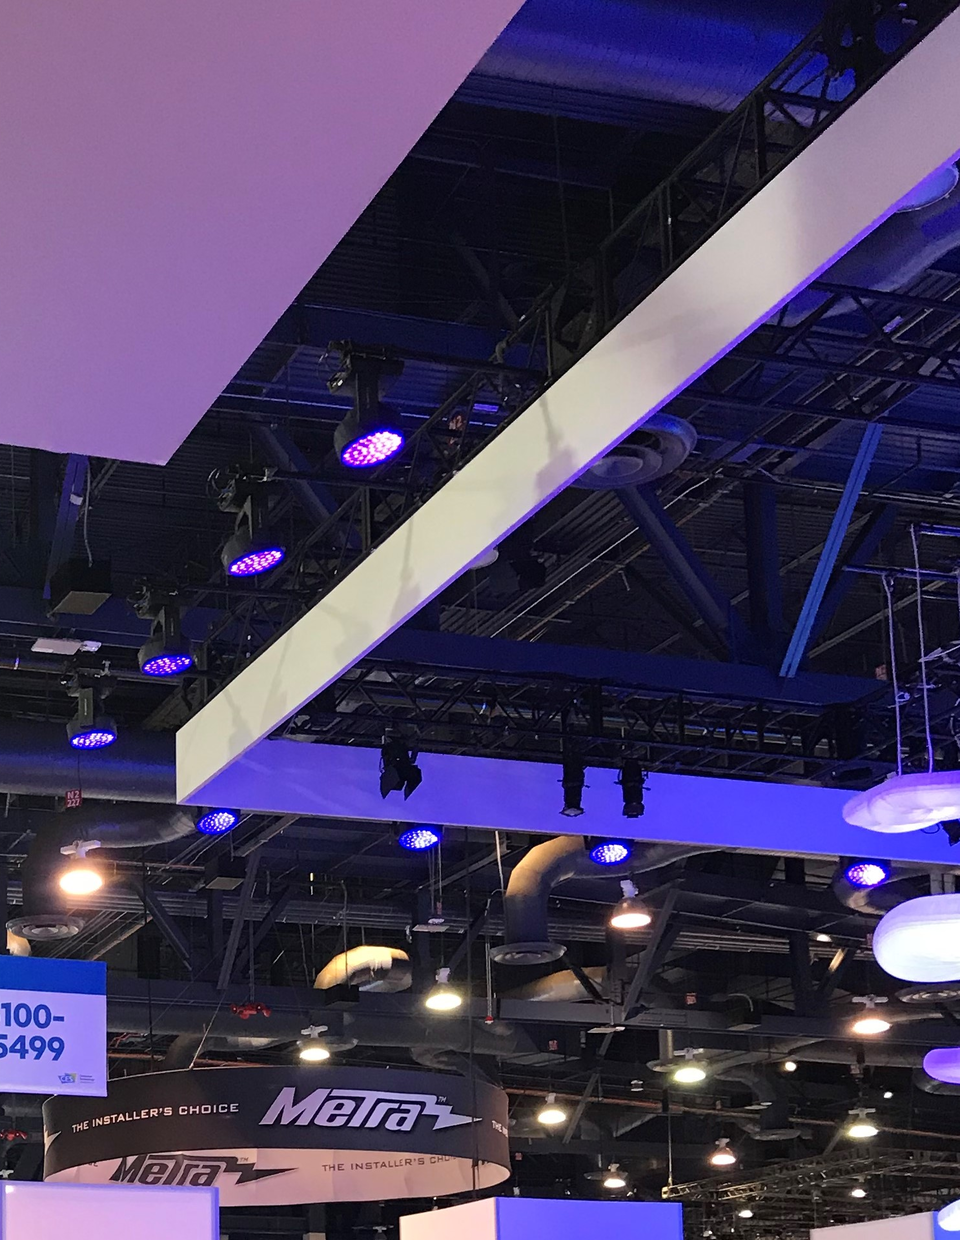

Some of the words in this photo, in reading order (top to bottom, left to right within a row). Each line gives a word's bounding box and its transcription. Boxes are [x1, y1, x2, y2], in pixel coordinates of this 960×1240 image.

[72, 1121, 89, 1134] THE
[92, 1107, 173, 1128] INSTALLER'S
[178, 1103, 240, 1116] CHOICE
[322, 1163, 346, 1172] THE
[350, 1156, 426, 1171] INSTALLER'S
